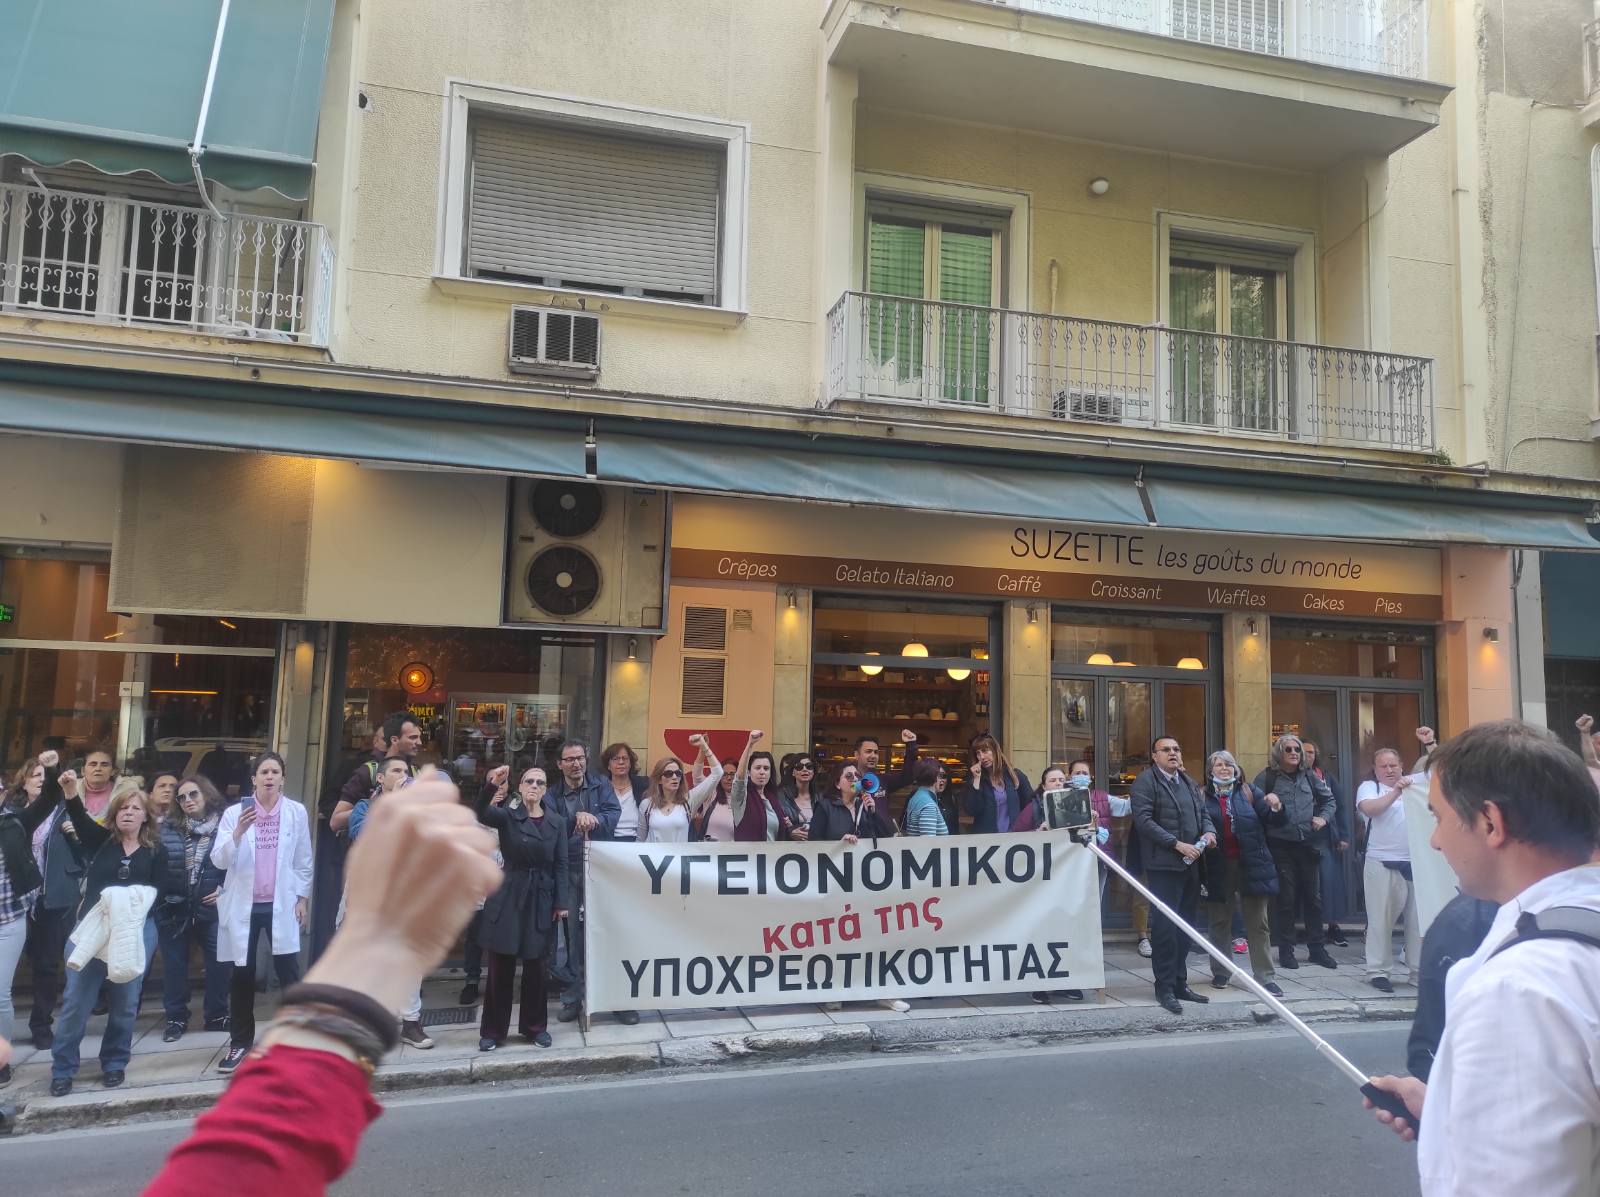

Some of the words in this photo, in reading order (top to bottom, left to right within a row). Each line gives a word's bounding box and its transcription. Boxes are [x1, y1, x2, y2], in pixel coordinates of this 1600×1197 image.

[1010, 527, 1145, 566] SUZETTE
[718, 557, 777, 579] Crêpes
[1156, 544, 1188, 569] les
[1193, 548, 1254, 575] goûts
[1260, 553, 1285, 575] du
[1292, 557, 1362, 580] monde
[835, 564, 890, 584] Gelato
[893, 566, 954, 588] Italiano
[1091, 579, 1163, 601] Croissant
[1207, 587, 1266, 607] Waffles
[1303, 593, 1345, 611] Cakes
[1374, 597, 1403, 615] Pies
[638, 842, 1052, 896] ΥΓΕΙΟΝΟΜΙΚΟΙ
[762, 903, 862, 954] κατά
[874, 896, 944, 935] της
[621, 941, 1070, 998] ΥΠΟΧΡΕΩΤΙΚΟΤΗΤΑΣ
